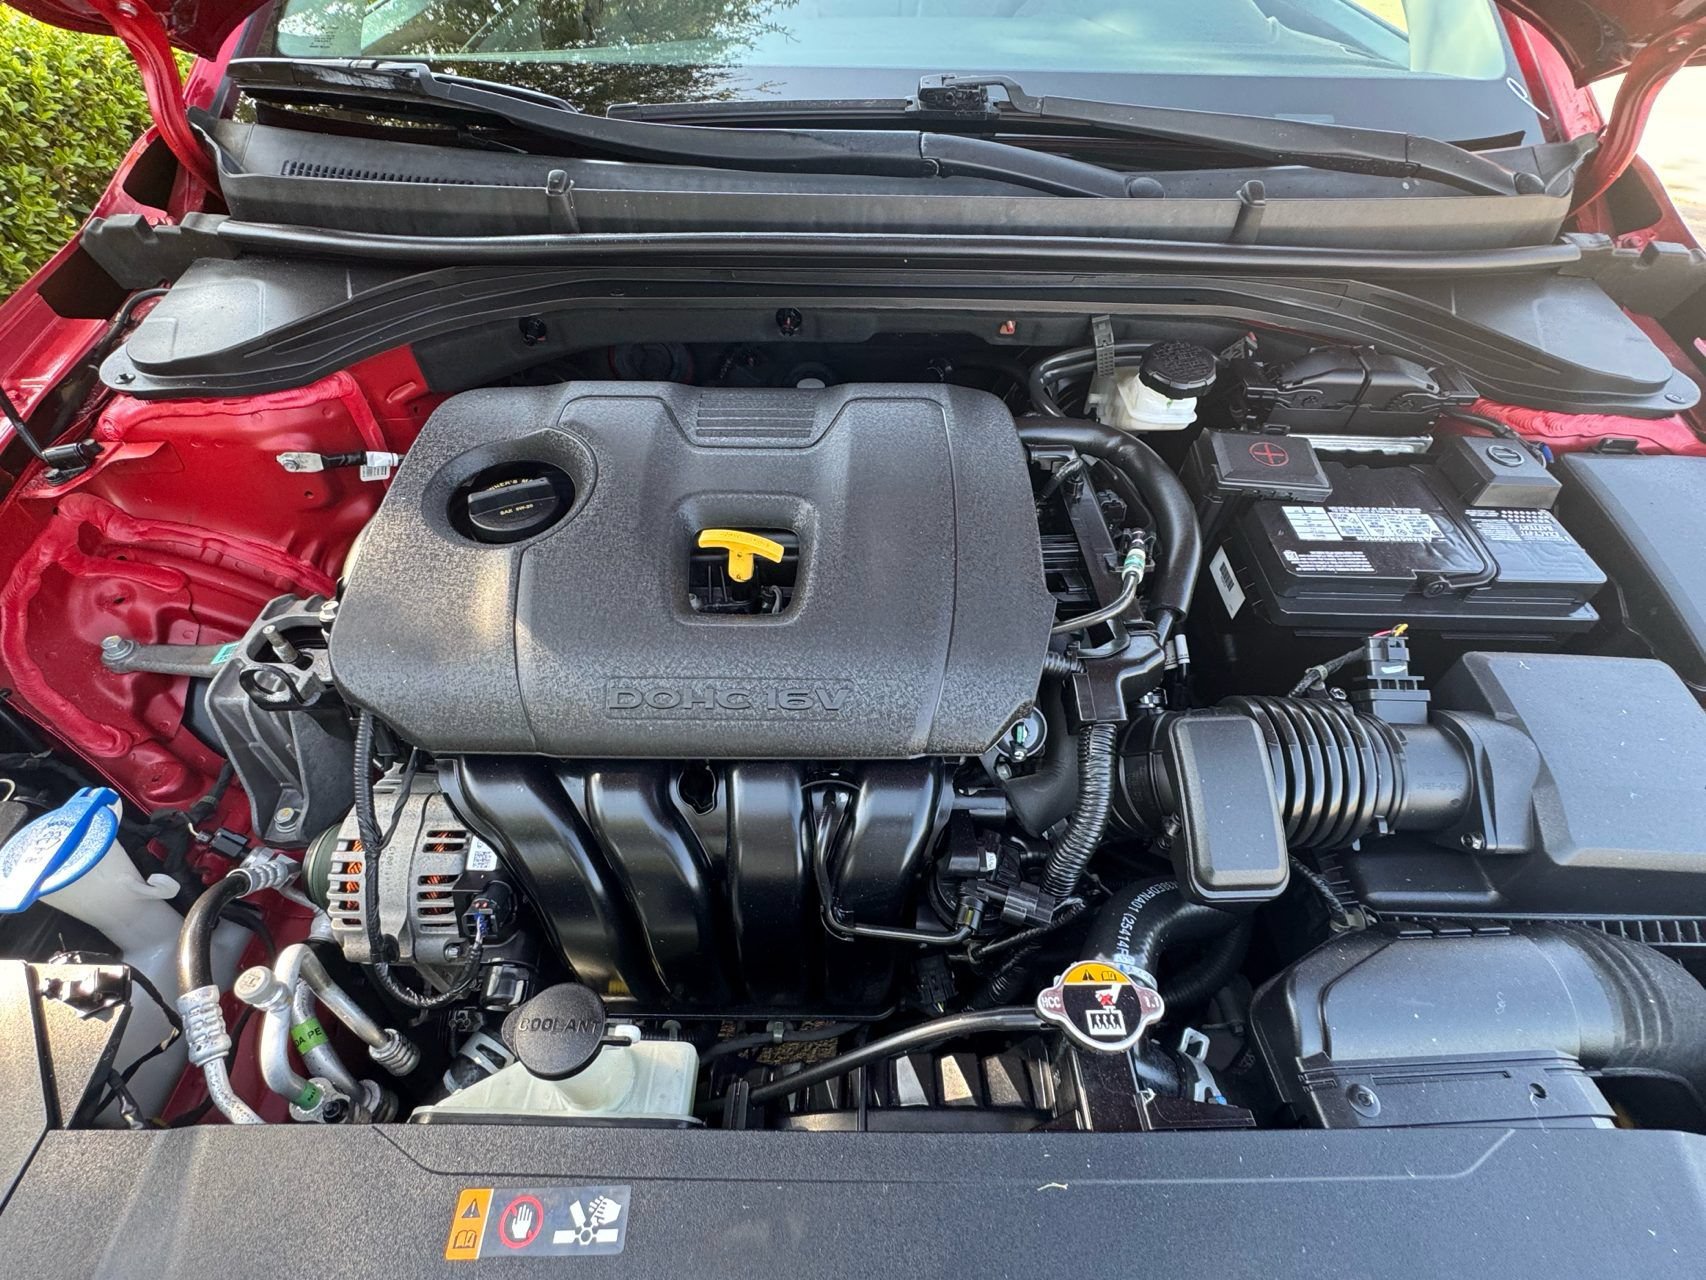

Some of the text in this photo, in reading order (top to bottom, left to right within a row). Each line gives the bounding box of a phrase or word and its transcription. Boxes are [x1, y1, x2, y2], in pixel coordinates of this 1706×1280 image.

[609, 687, 850, 711] DOHC 16V
[1041, 996, 1061, 1008] HCC
[519, 1017, 599, 1034] COOLANT
